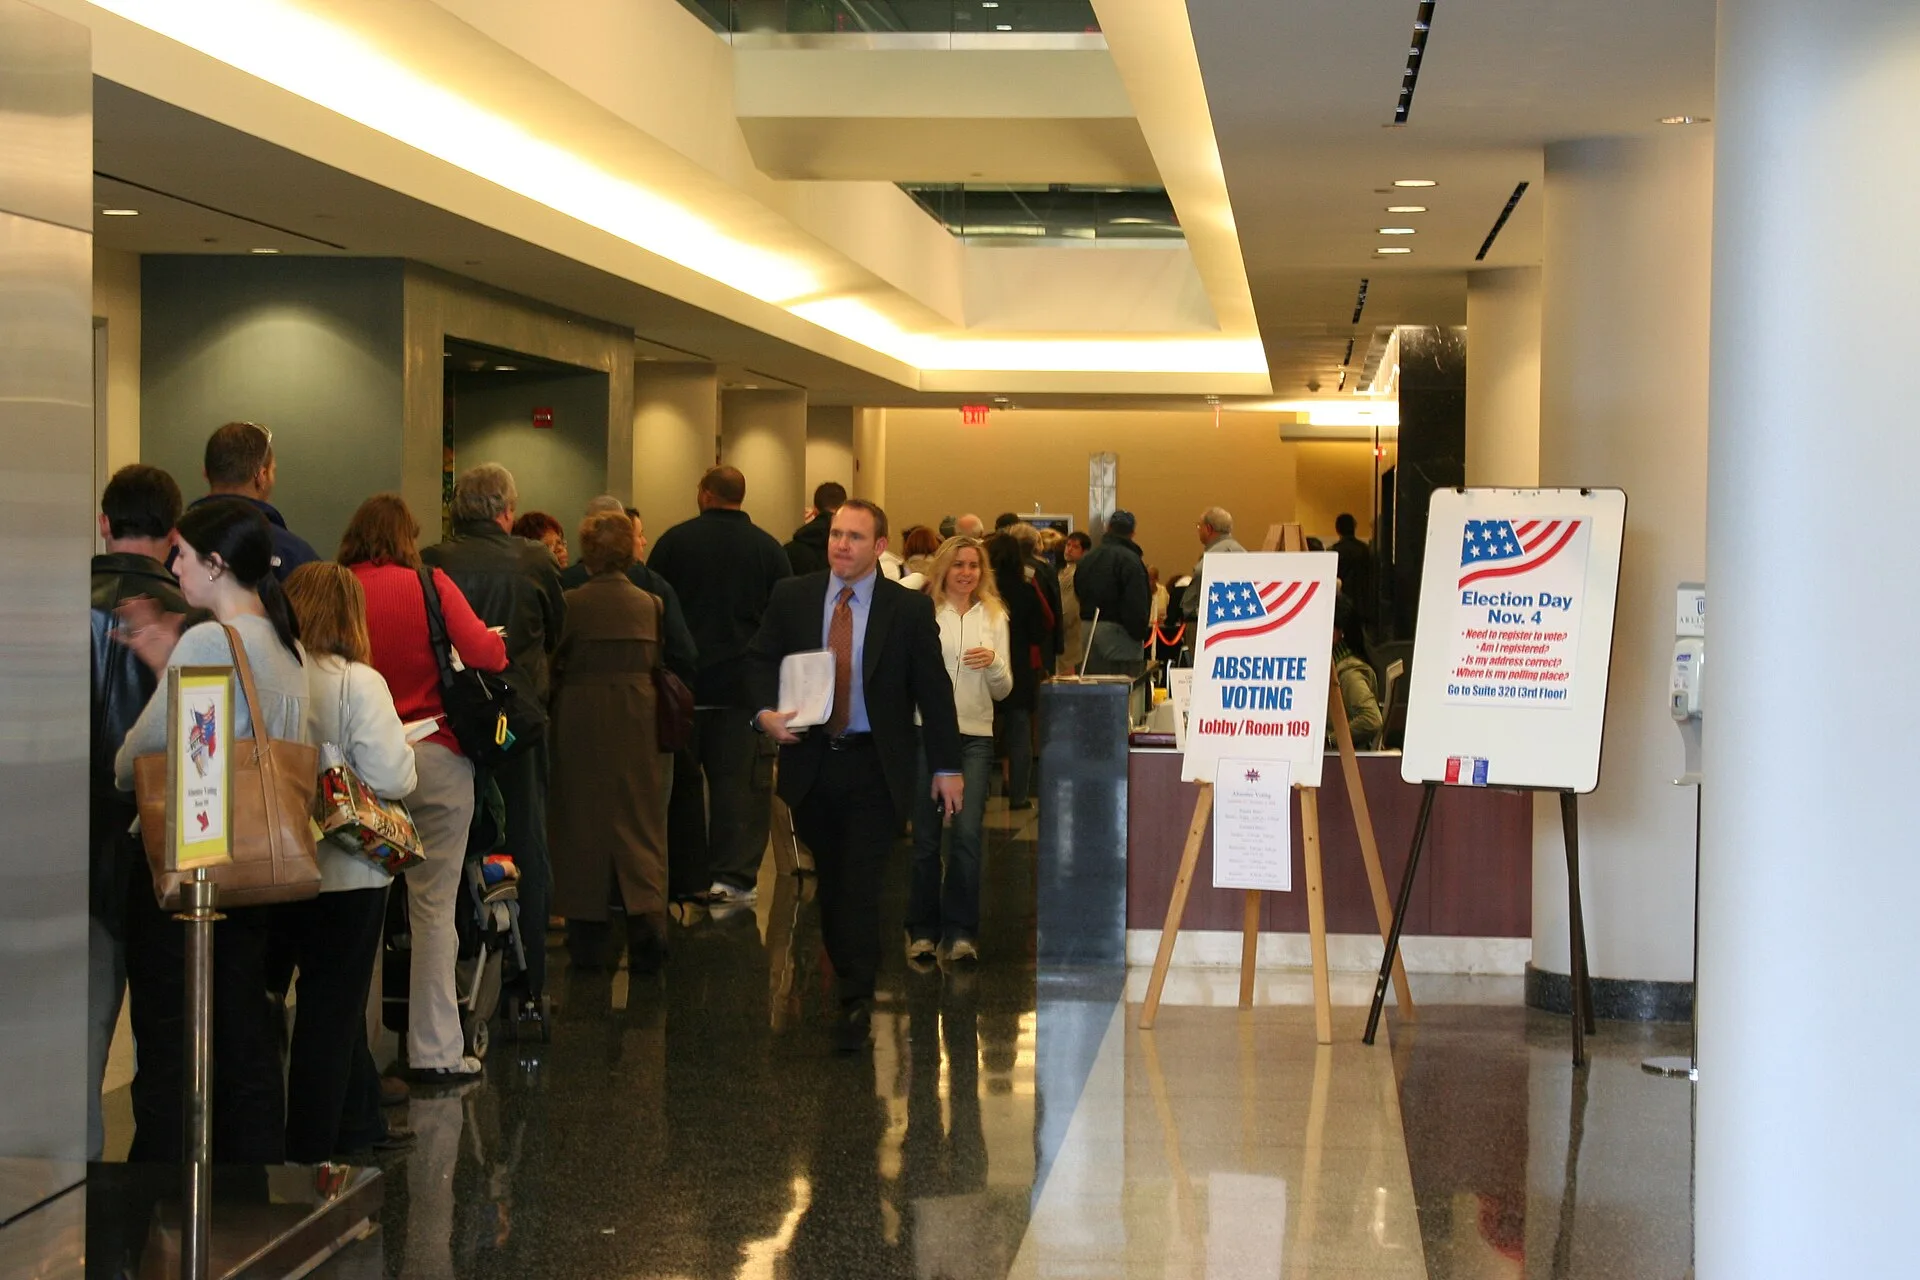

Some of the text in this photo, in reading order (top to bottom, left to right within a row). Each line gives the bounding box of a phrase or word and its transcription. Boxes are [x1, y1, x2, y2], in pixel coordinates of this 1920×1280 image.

[963, 406, 988, 425] EXIT
[1462, 590, 1573, 611] Election Day
[1488, 609, 1542, 625] Nov. 4
[1466, 629, 1568, 642] Need to register to vote?
[1480, 642, 1495, 653] Am
[1500, 643, 1550, 655] registered?
[1212, 656, 1307, 680] ABSENTEE
[1466, 655, 1562, 668] Is my address correct?
[1456, 668, 1570, 682] Where is my polling place?
[1221, 685, 1293, 710] VOTING
[1447, 684, 1568, 700] Go to Suite 320 (3rd Floor)
[1286, 719, 1310, 737] 109
